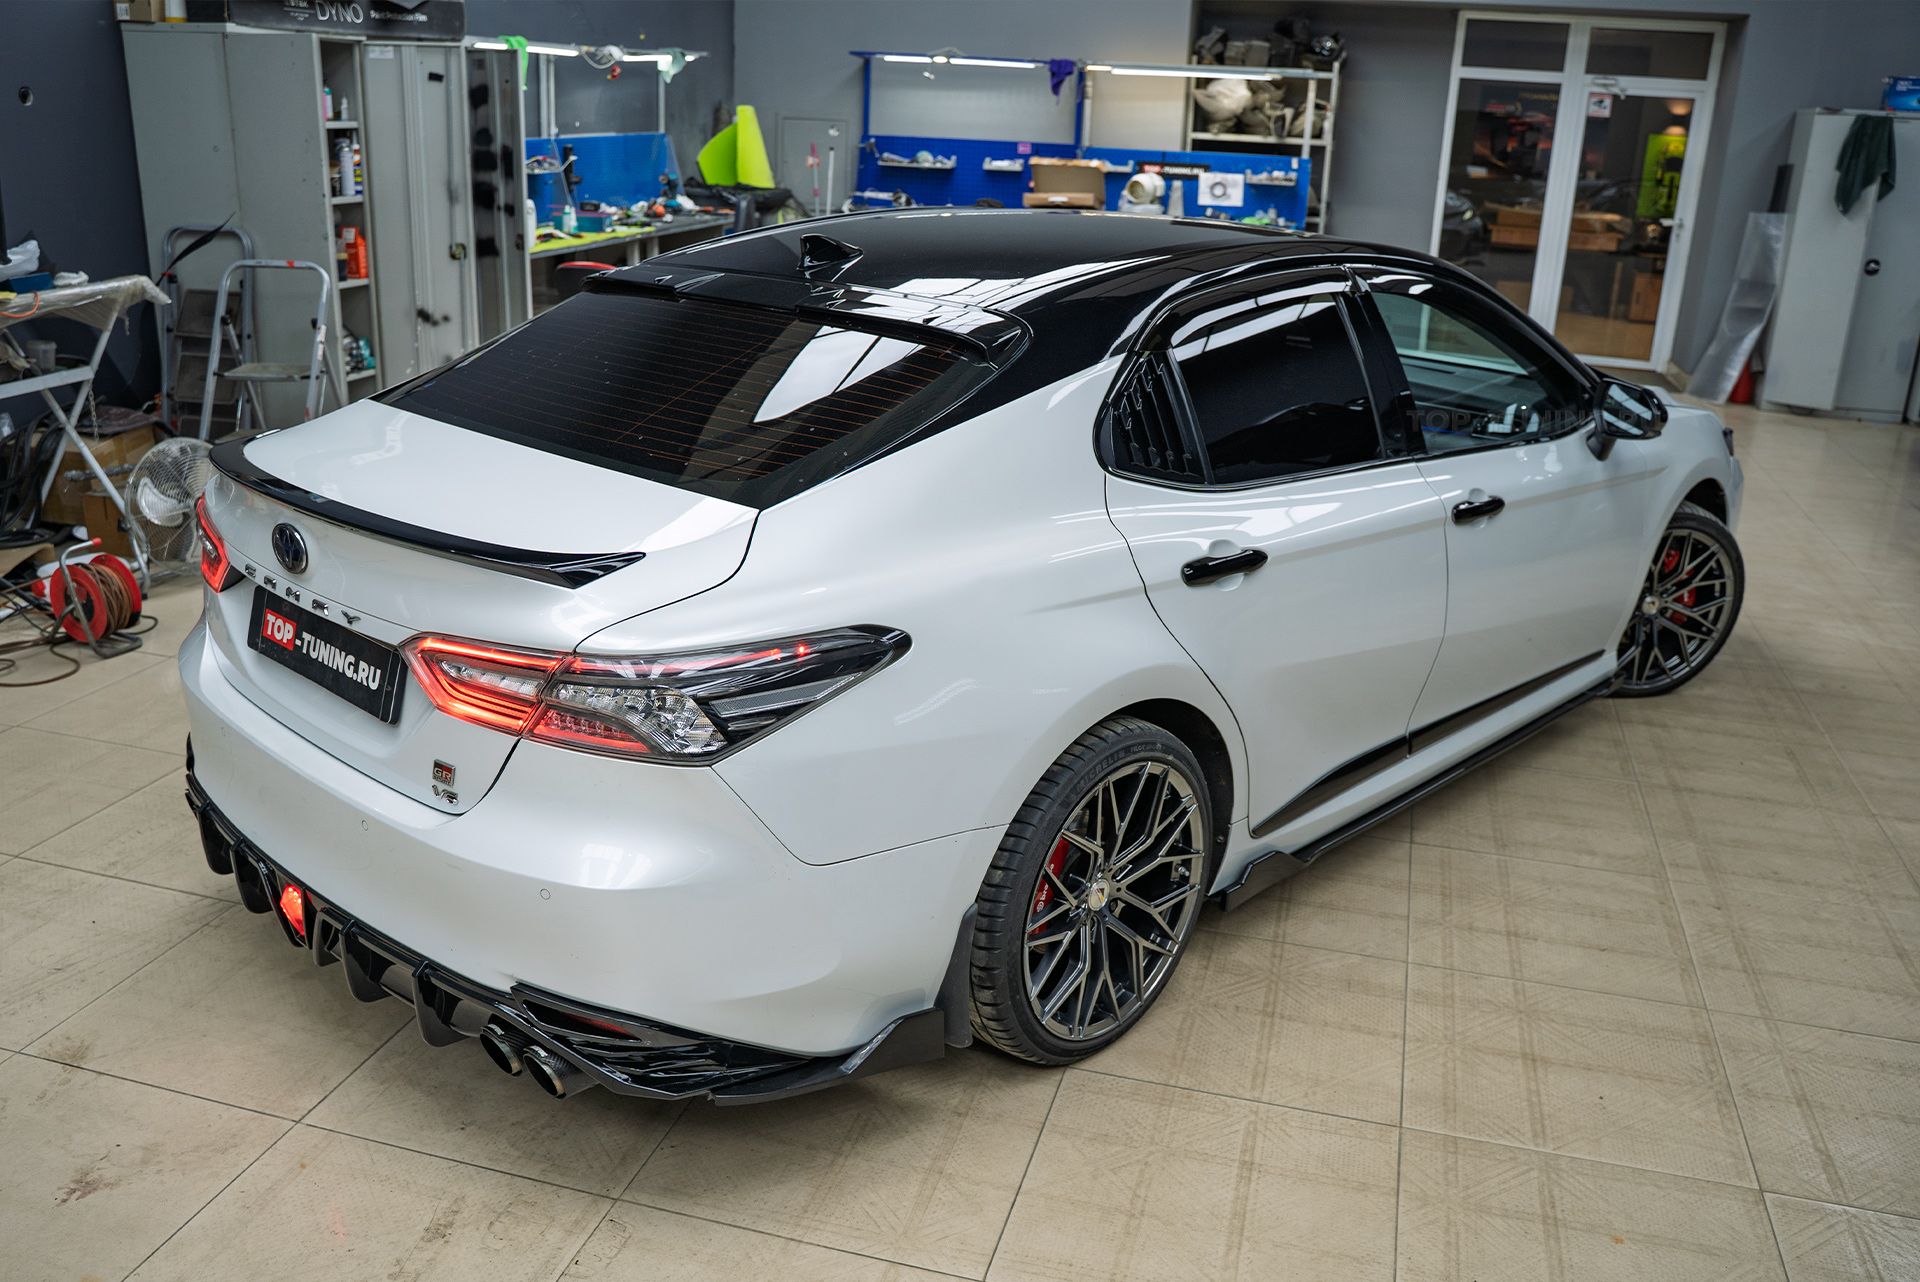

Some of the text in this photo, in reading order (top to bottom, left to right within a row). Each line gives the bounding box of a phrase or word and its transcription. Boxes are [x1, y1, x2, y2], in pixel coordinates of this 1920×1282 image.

[315, 1, 364, 24] DYNO
[244, 563, 362, 626] CAMRY
[266, 612, 382, 692] TOP-TUNING.RU
[434, 767, 452, 782] GR
[1076, 749, 1126, 793] MICHELIN
[432, 784, 459, 806] V6
